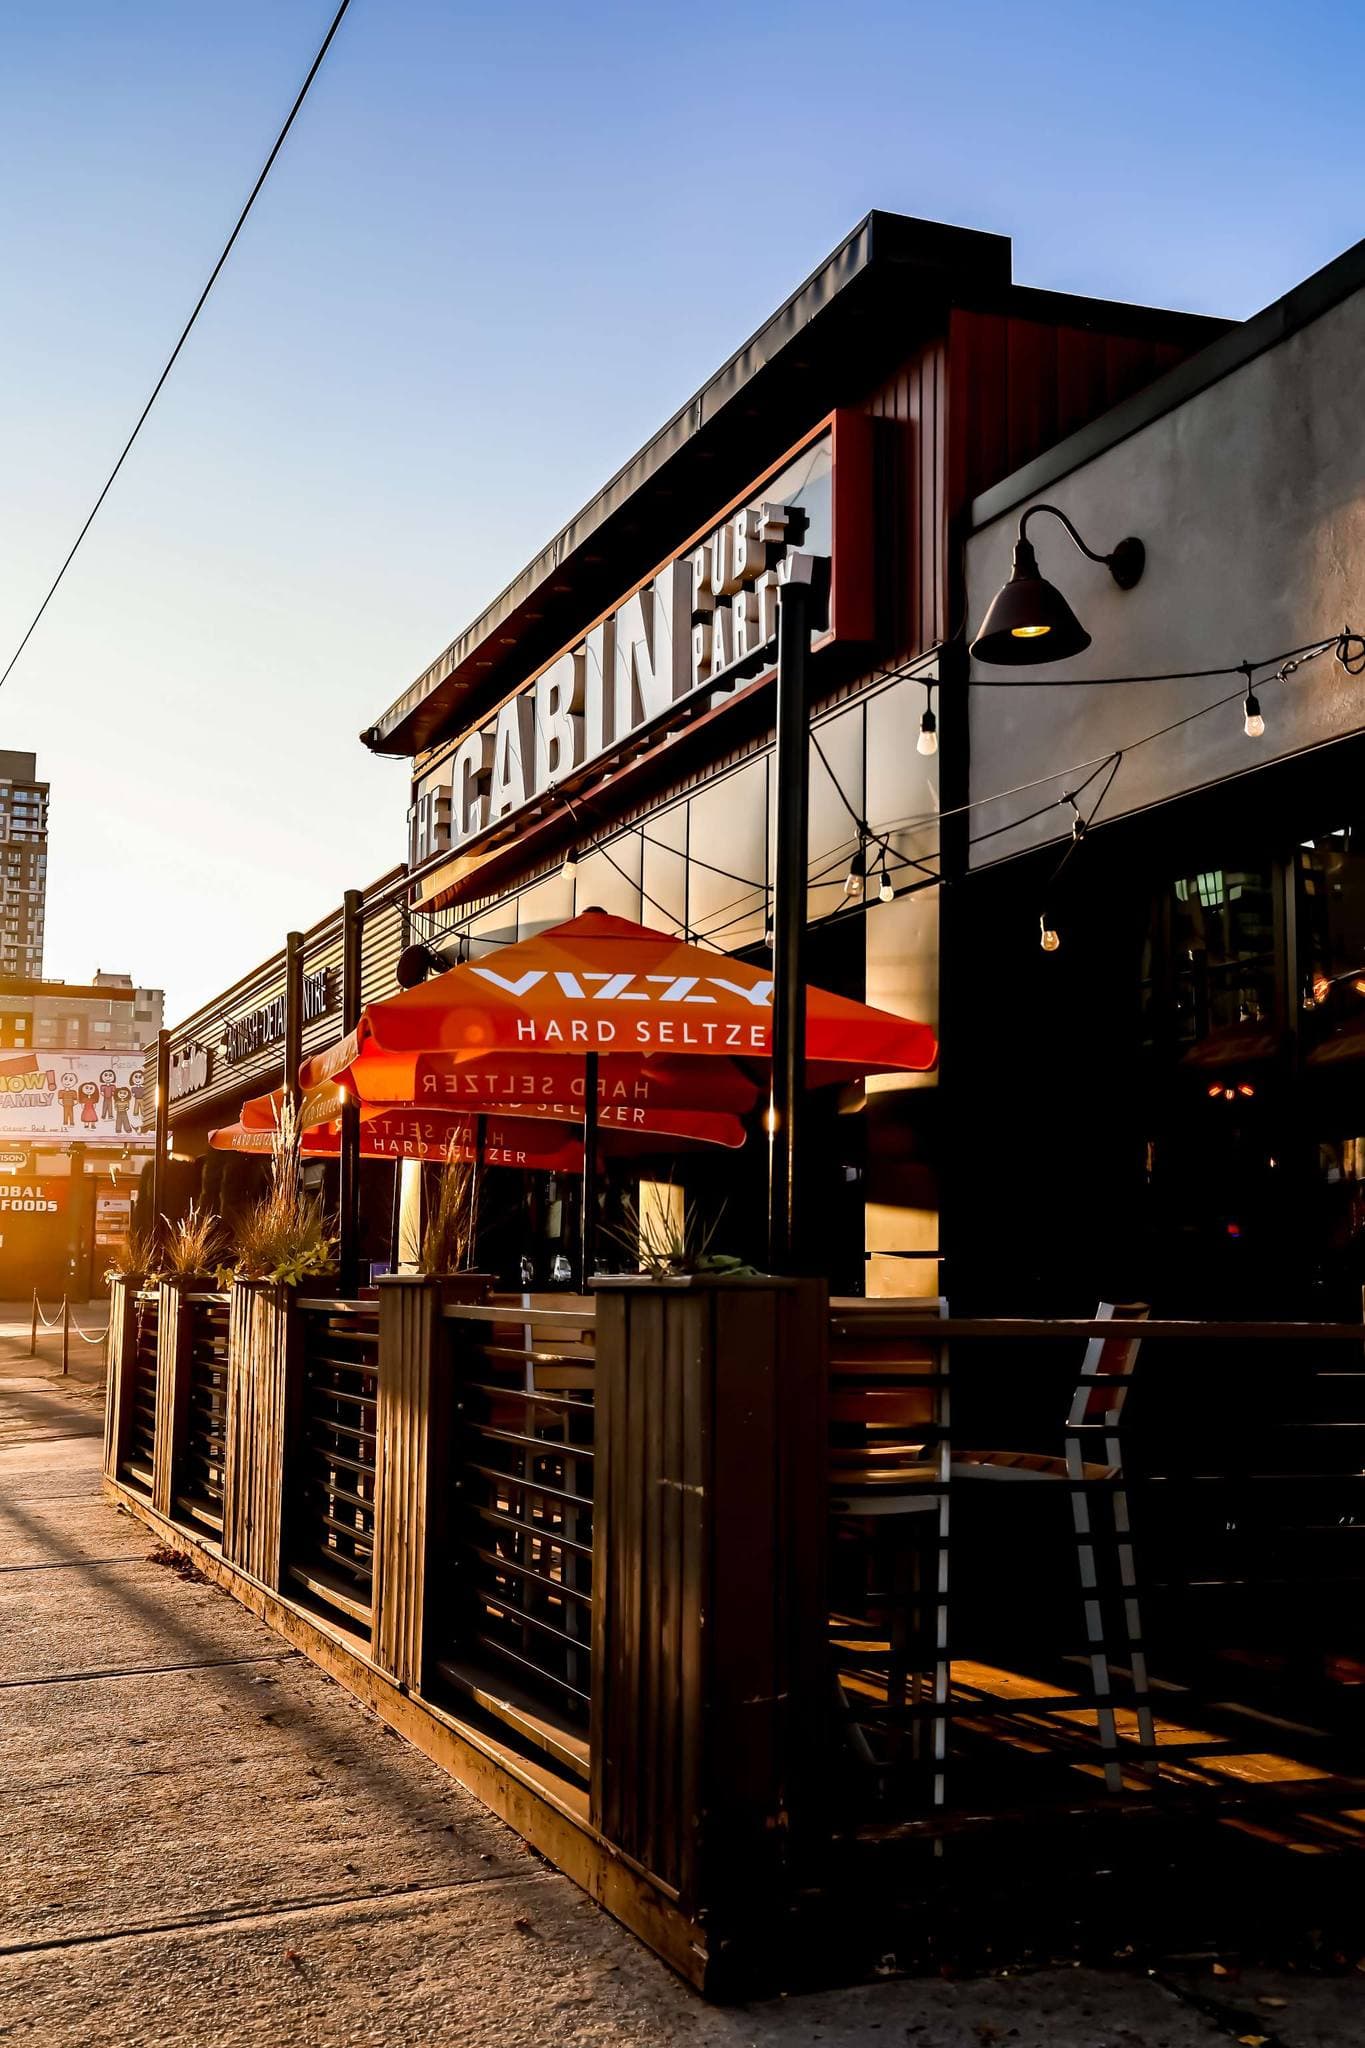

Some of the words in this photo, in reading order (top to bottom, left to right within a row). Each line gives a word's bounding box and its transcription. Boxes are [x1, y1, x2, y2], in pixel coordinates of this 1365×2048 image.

[692, 508, 754, 613] PUB
[407, 785, 448, 872] THE
[452, 558, 684, 852] CABIN
[469, 967, 774, 1007] VIZZY
[263, 991, 287, 1043] DETAI
[516, 1018, 616, 1042] HARD
[636, 1020, 767, 1047] SELTZE
[537, 1103, 647, 1123] ELZER
[374, 1138, 429, 1154] HARD
[440, 1144, 526, 1164] SELZER
[1, 1199, 58, 1212] FOODS
